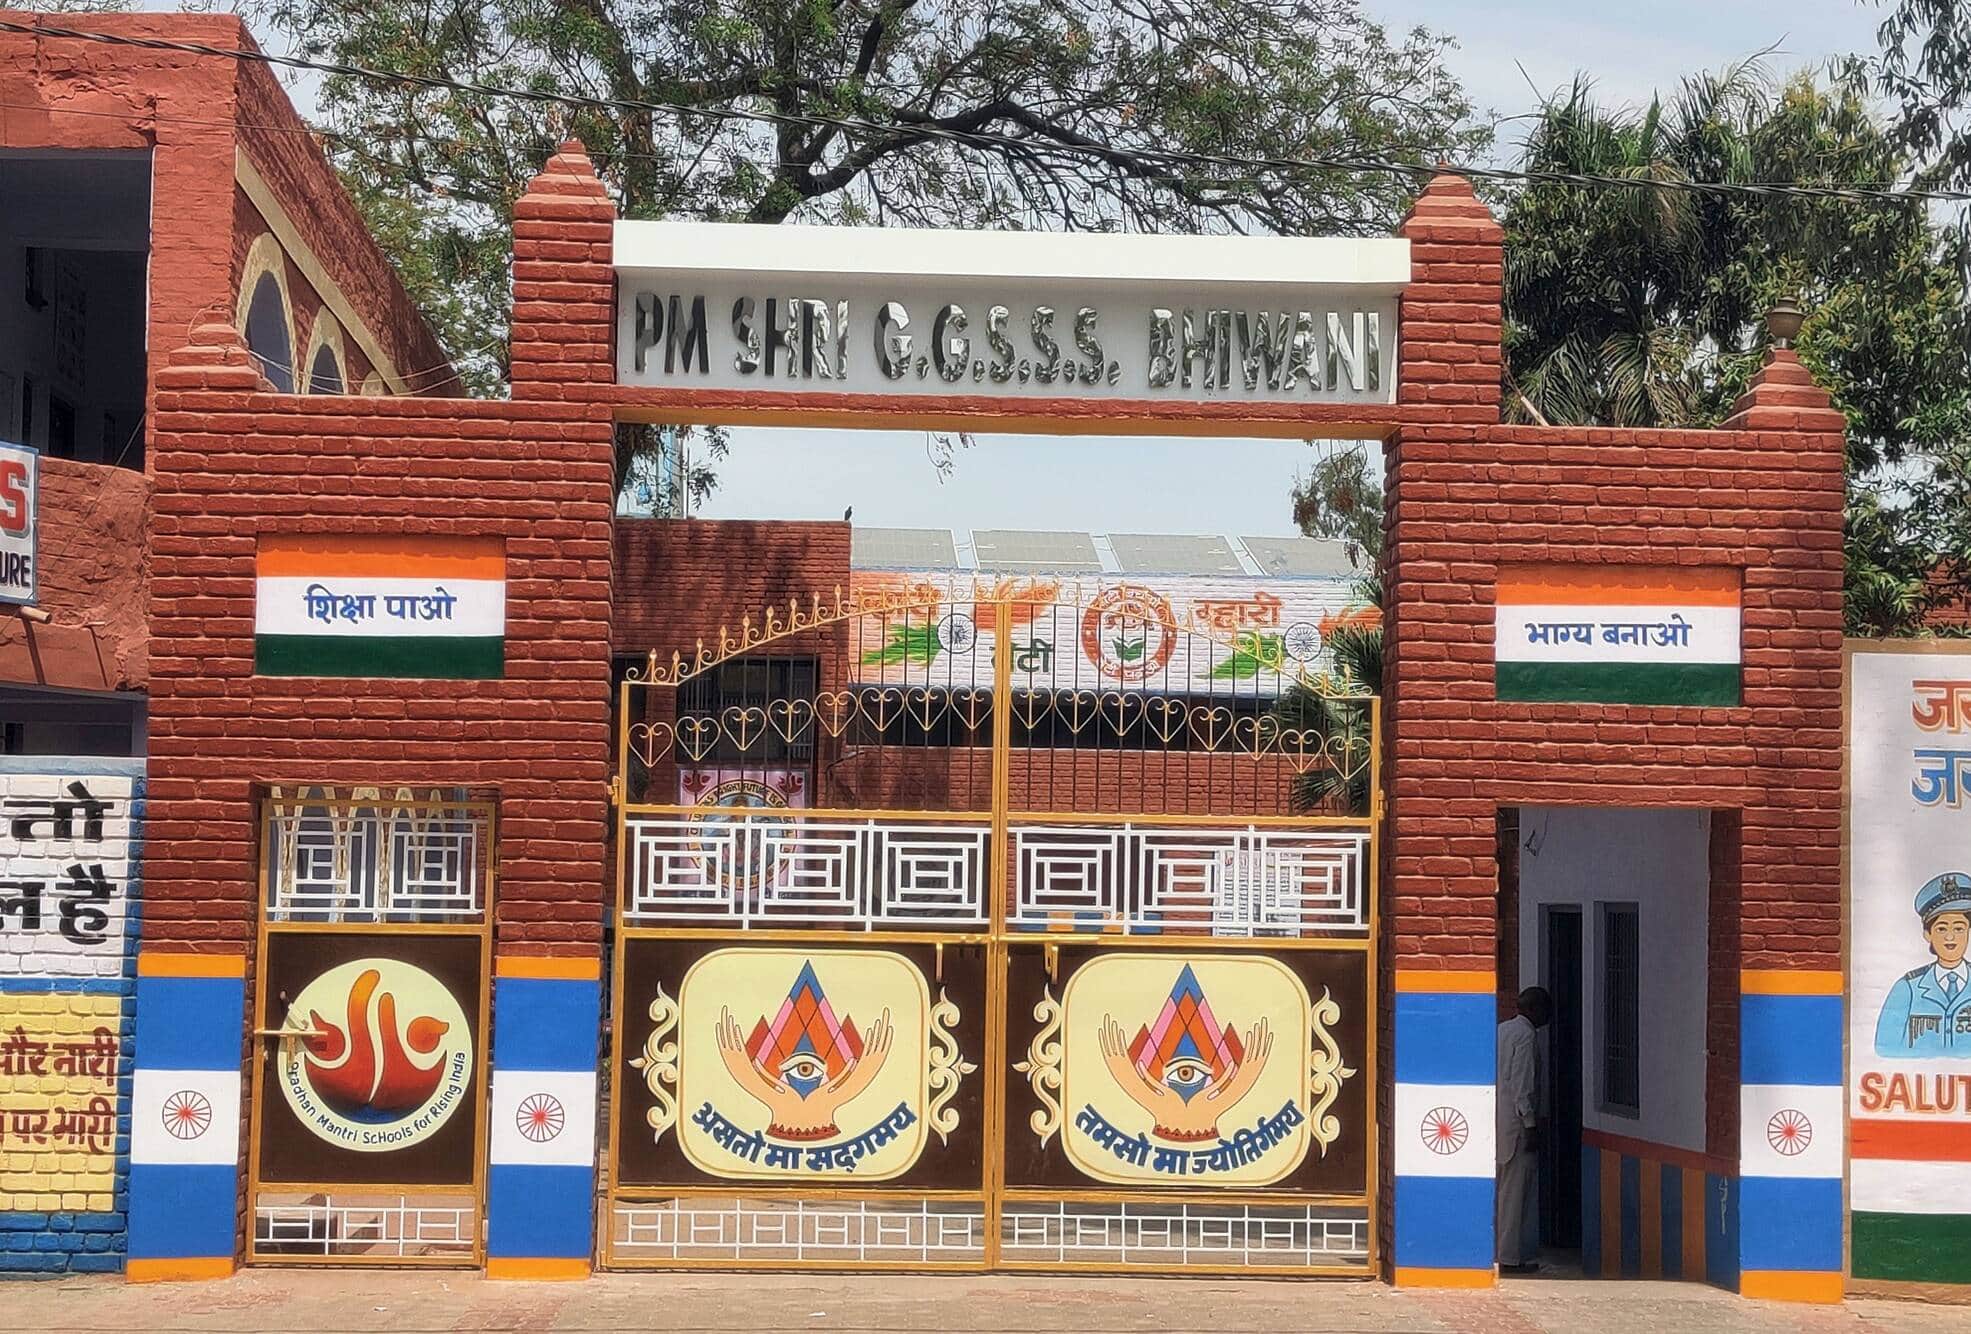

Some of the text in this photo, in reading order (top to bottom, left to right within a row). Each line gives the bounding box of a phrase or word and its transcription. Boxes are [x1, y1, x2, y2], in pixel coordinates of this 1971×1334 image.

[634, 292, 710, 374] PM
[732, 295, 849, 380] SHRI
[1147, 308, 1380, 392] BHIWANI
[304, 583, 457, 625] शिक्षा पाओ
[1525, 613, 1693, 648] भाग्य बनाओ
[1912, 680, 1971, 731] ज
[1912, 749, 1971, 808] ज
[4, 780, 114, 843] तो
[56, 863, 117, 945] है
[53, 1026, 118, 1087] नारी
[11, 1108, 49, 1145] पर
[53, 1096, 116, 1155] भारी
[316, 1114, 358, 1142] Mantri
[414, 1113, 432, 1131] for
[429, 1084, 463, 1118] Rising
[448, 1052, 466, 1082] India
[691, 1101, 918, 1173] असतो मा सद्गमय
[1075, 1103, 1153, 1166] तमसो
[1153, 1147, 1191, 1175] मा
